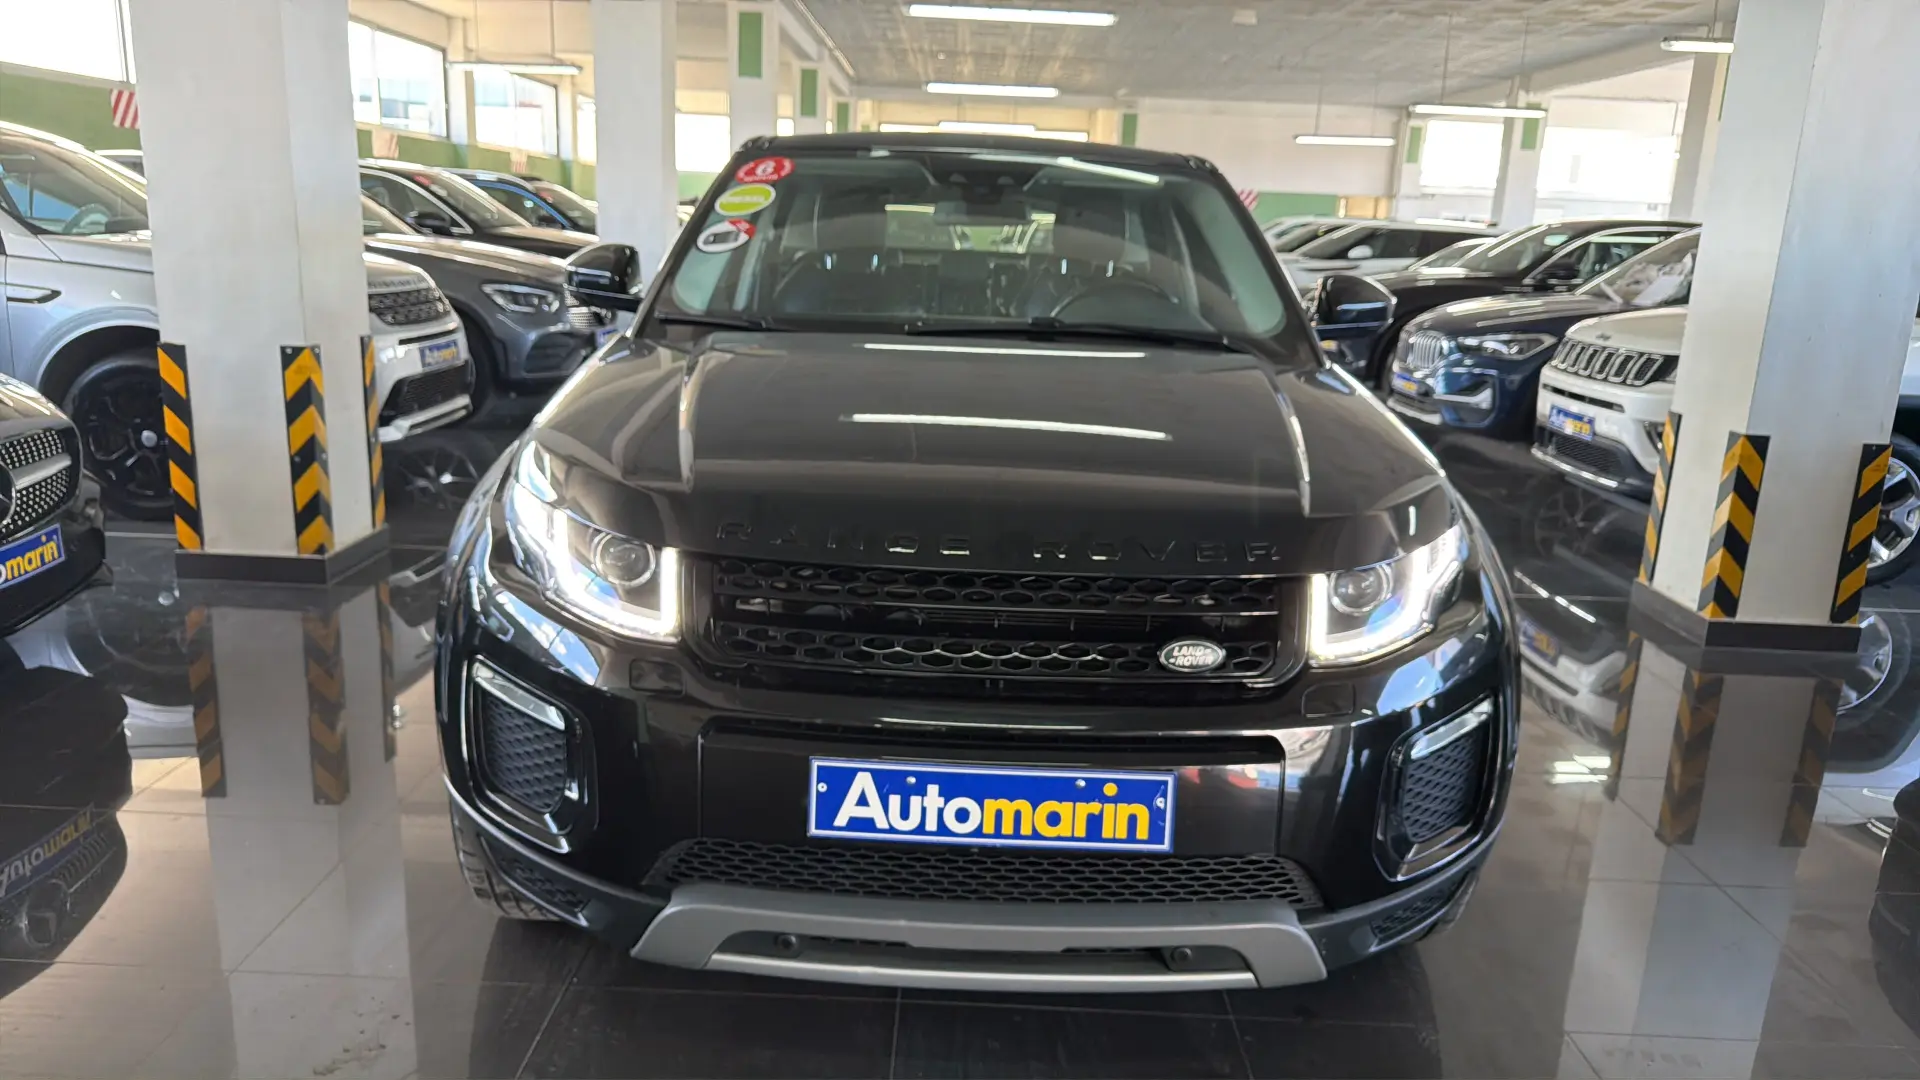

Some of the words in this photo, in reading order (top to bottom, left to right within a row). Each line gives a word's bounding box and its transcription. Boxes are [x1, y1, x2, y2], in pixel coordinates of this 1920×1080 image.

[716, 522, 970, 555] RANGE
[1033, 540, 1280, 561] ROVER
[1173, 645, 1205, 657] LAND
[833, 771, 1150, 840] Automarin
